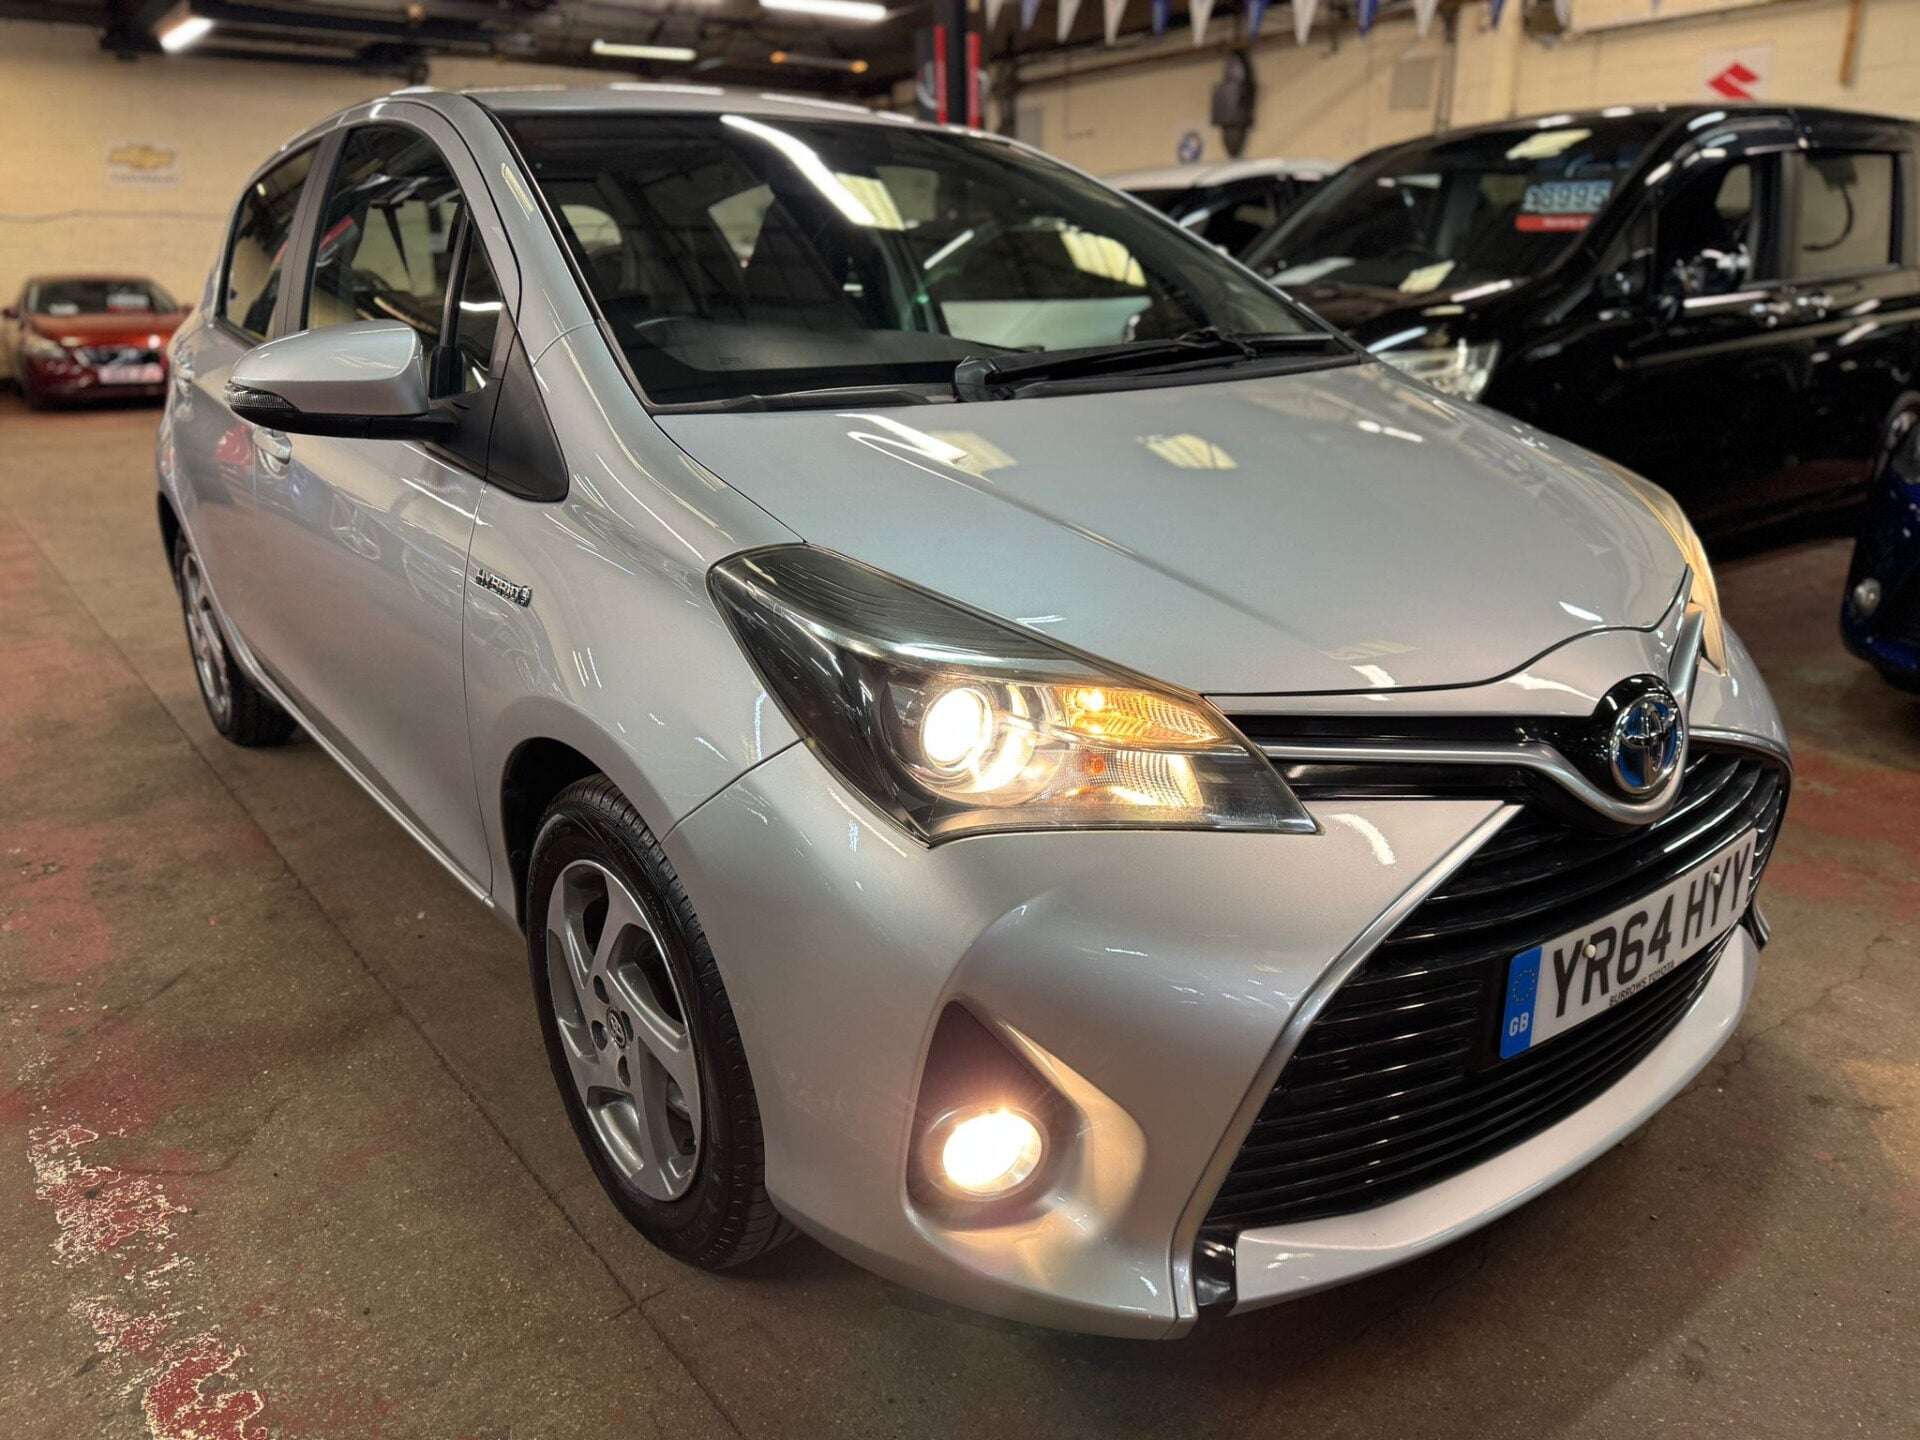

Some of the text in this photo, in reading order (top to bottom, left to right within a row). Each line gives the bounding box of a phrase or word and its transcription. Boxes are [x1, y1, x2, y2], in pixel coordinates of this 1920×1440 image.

[1553, 843, 1751, 1018] YR64 HYY
[1509, 1013, 1529, 1036] GB
